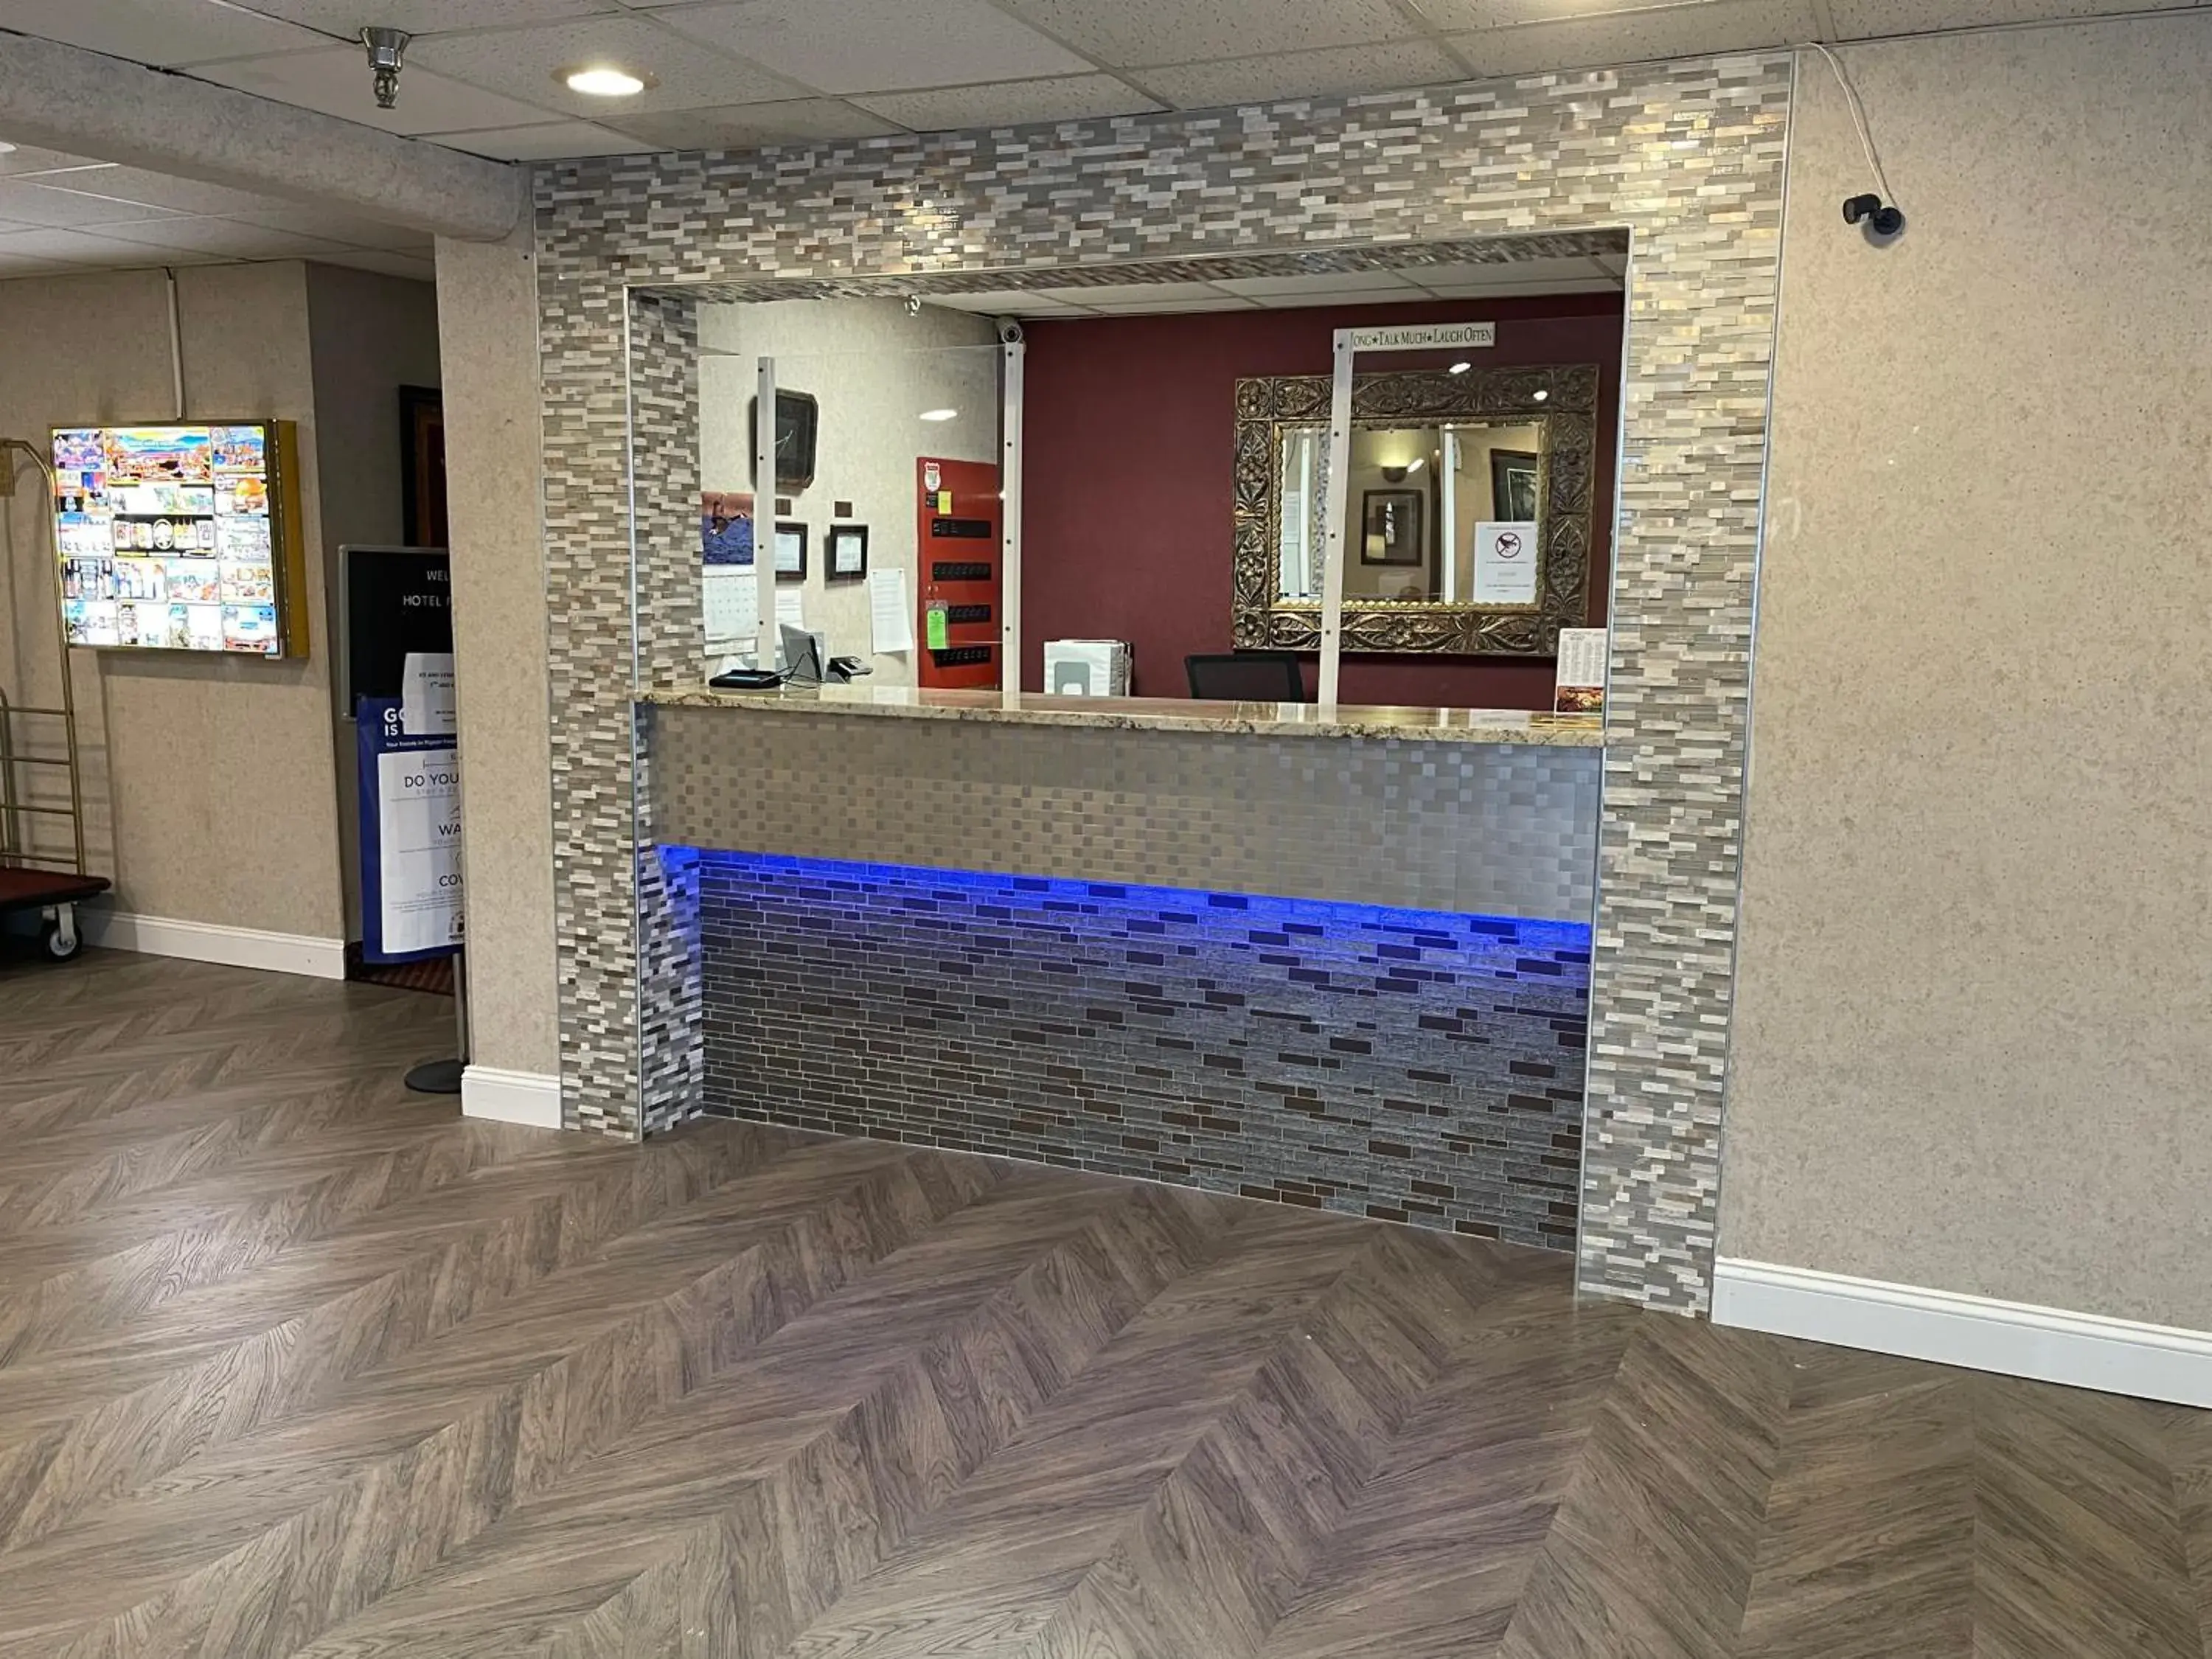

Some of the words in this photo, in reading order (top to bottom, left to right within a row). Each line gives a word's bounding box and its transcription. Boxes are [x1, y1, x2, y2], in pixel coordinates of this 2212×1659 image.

[1378, 330, 1400, 346] TALK
[1401, 330, 1427, 344] MUCH
[1433, 328, 1463, 343] LAUGH
[1464, 326, 1492, 342] OFTEN
[403, 595, 442, 607] HOTEL
[384, 724, 398, 736] IS
[405, 775, 425, 787] DO
